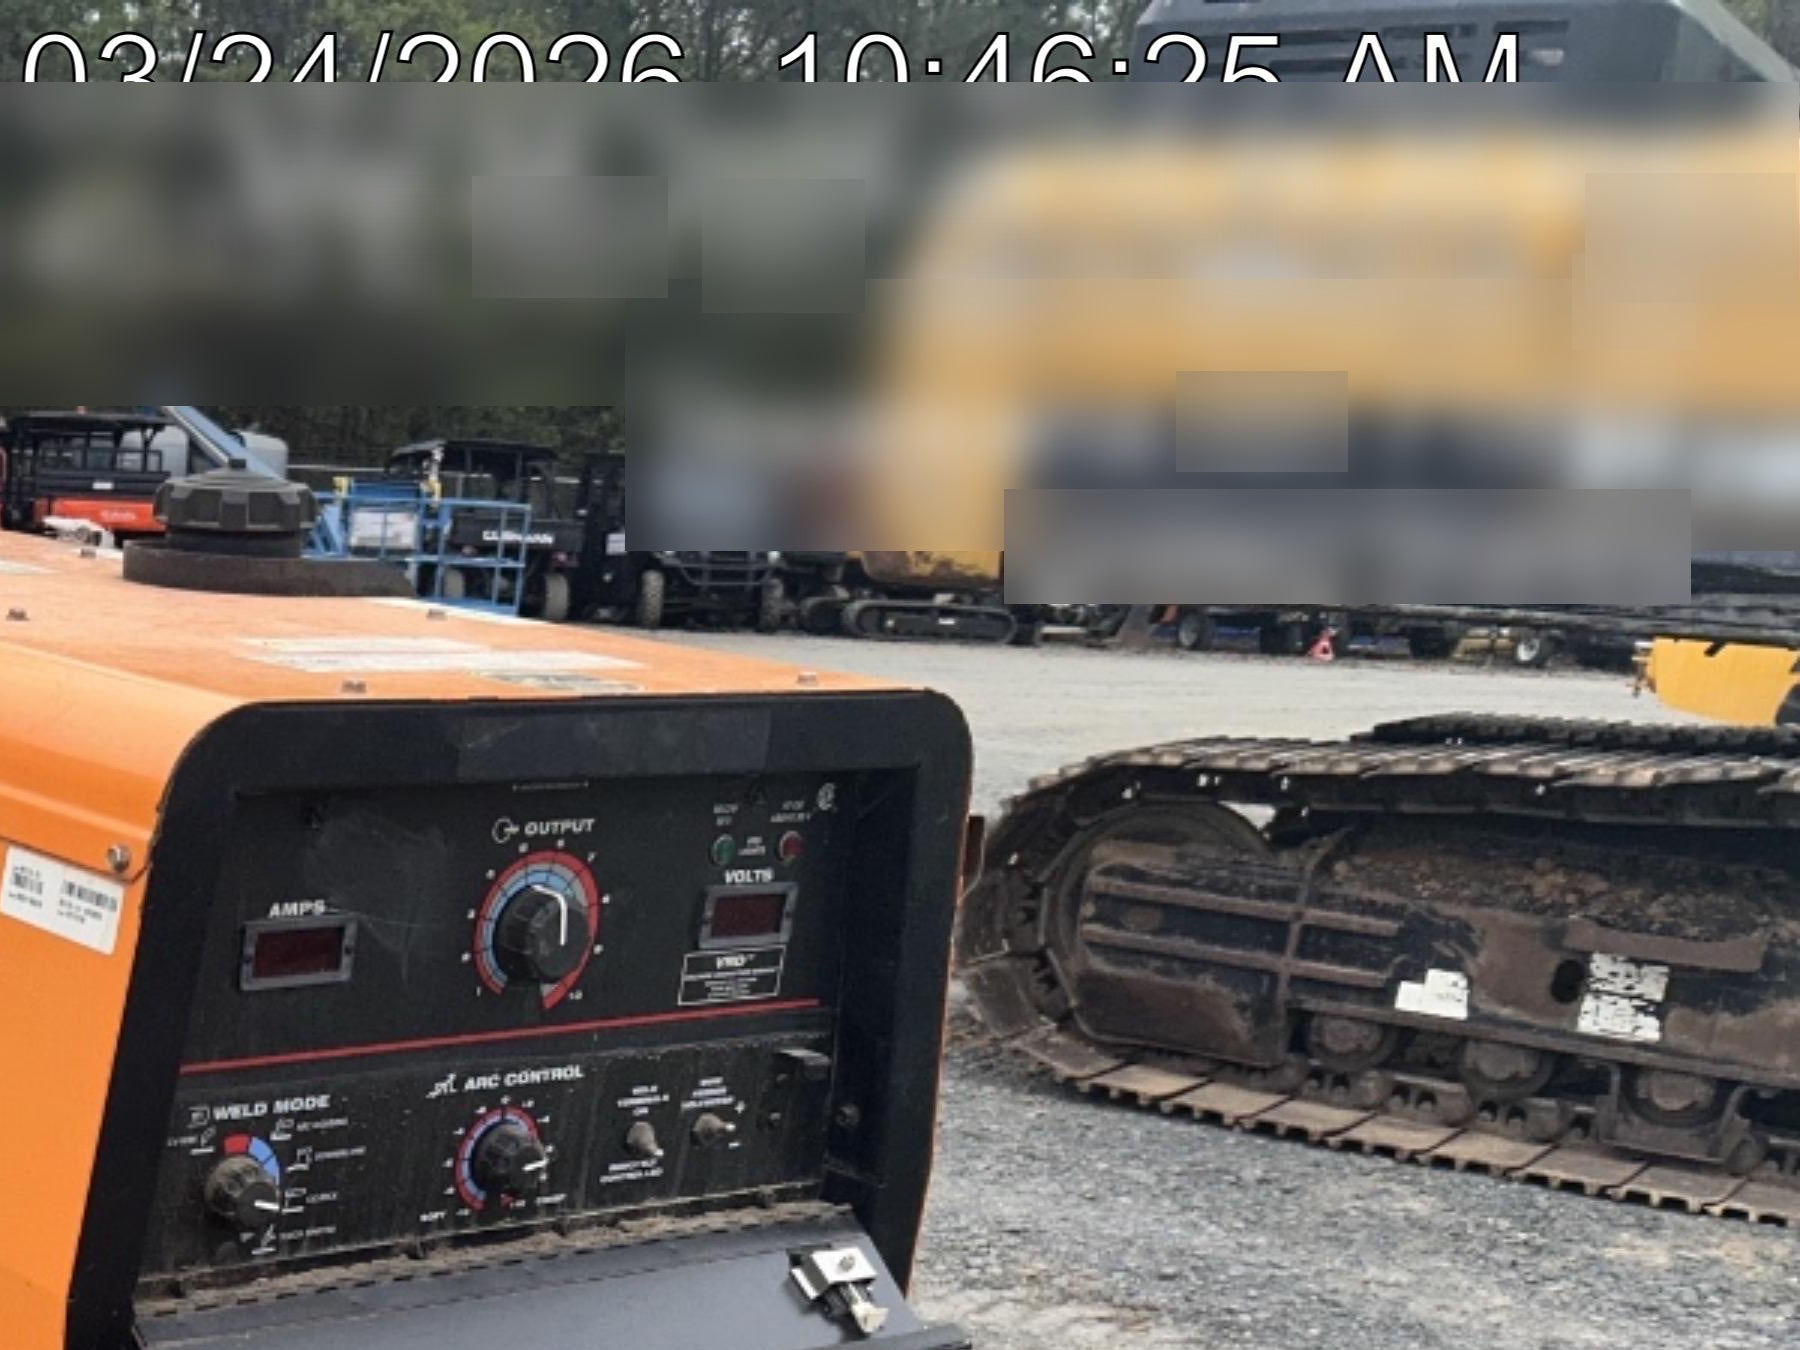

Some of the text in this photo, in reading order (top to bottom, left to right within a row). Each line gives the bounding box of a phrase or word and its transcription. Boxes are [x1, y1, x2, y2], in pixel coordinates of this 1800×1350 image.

[524, 818, 596, 836] OUTPUT
[724, 868, 774, 884] VOLTS
[267, 899, 327, 919] AMPS
[464, 1065, 584, 1091] ARC CONTROL
[213, 1094, 331, 1121] WELD MODE
